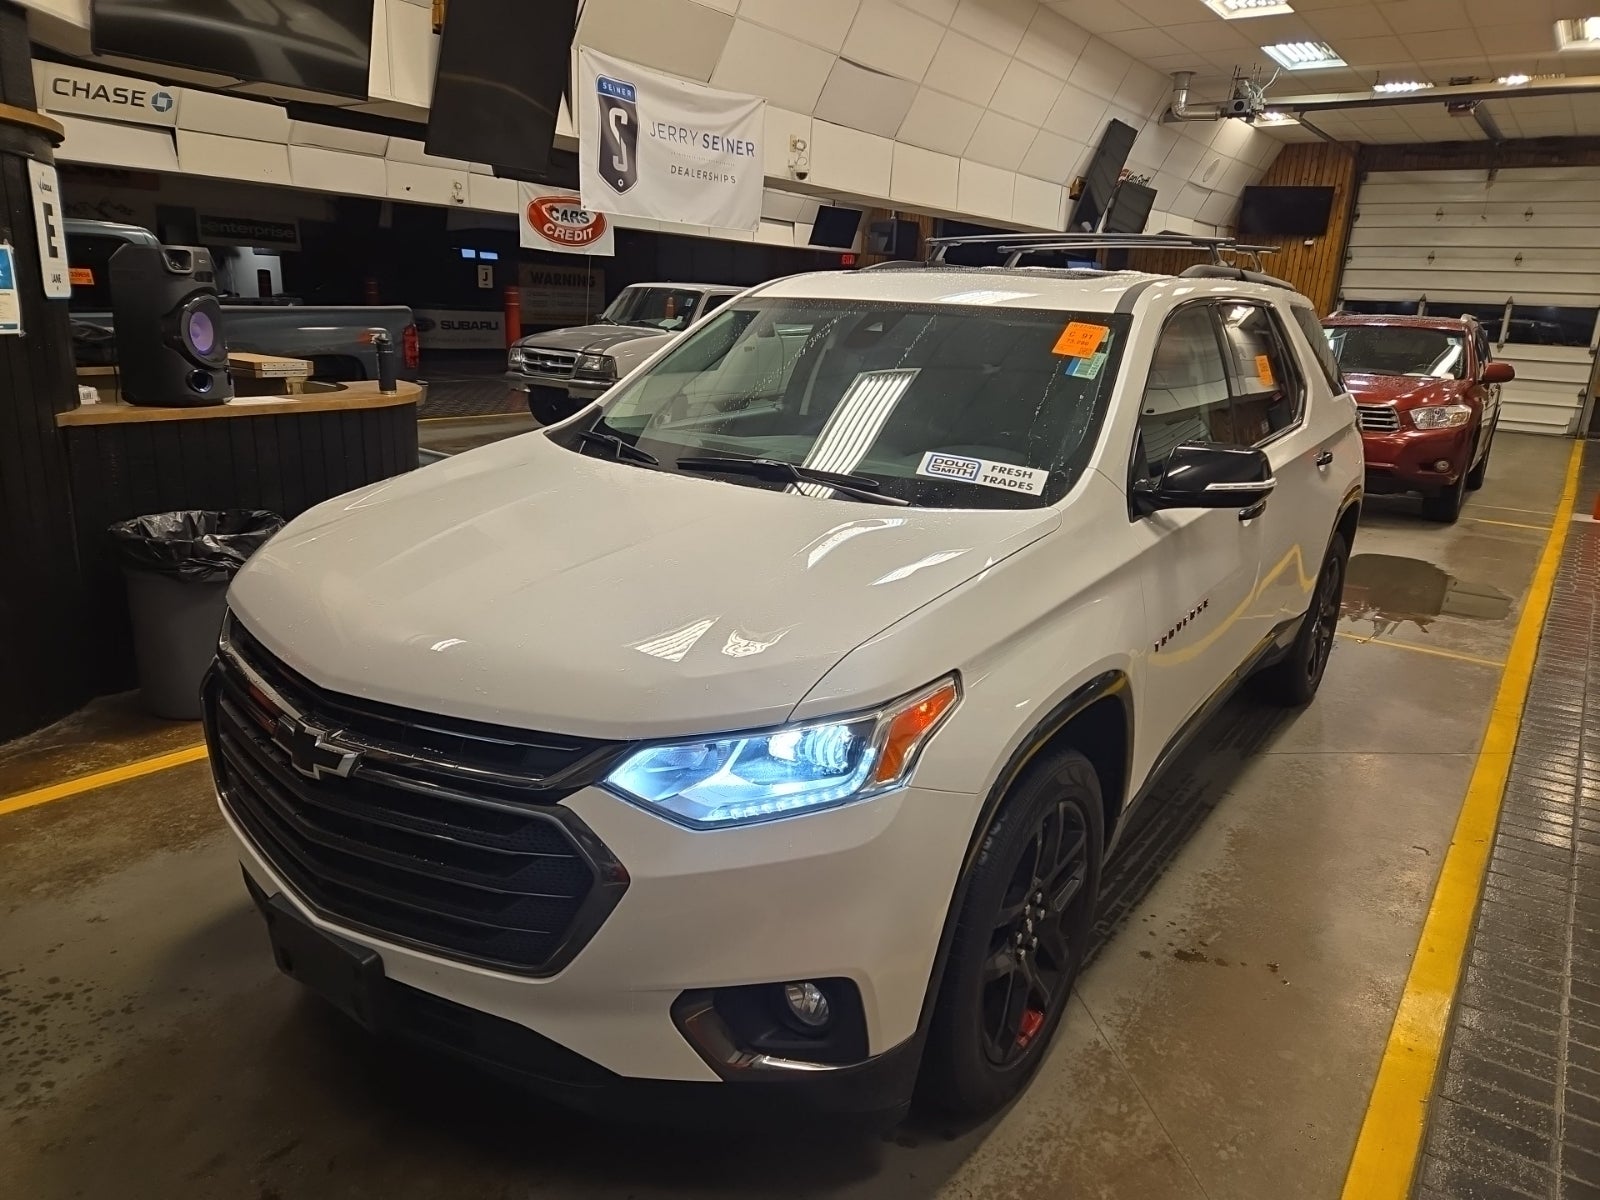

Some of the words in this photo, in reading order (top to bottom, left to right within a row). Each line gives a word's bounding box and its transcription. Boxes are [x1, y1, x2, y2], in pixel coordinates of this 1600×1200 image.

[52, 78, 146, 107] CHASE
[602, 82, 632, 97] SEINER
[609, 108, 628, 172] S
[650, 121, 699, 146] JERRY
[702, 133, 755, 157] SEINER
[670, 165, 736, 184] DEALERSHIPS
[550, 207, 590, 224] CARS
[42, 202, 59, 258] E
[203, 222, 296, 239] enterprise
[543, 223, 593, 241] CREDIT
[482, 271, 489, 281] J
[530, 271, 596, 288] WARNING
[440, 320, 499, 331] SUBARU
[931, 464, 974, 478] SMITH
[933, 457, 976, 470] DOUG
[990, 465, 1033, 479] FRESH
[982, 475, 1034, 491] TRADES
